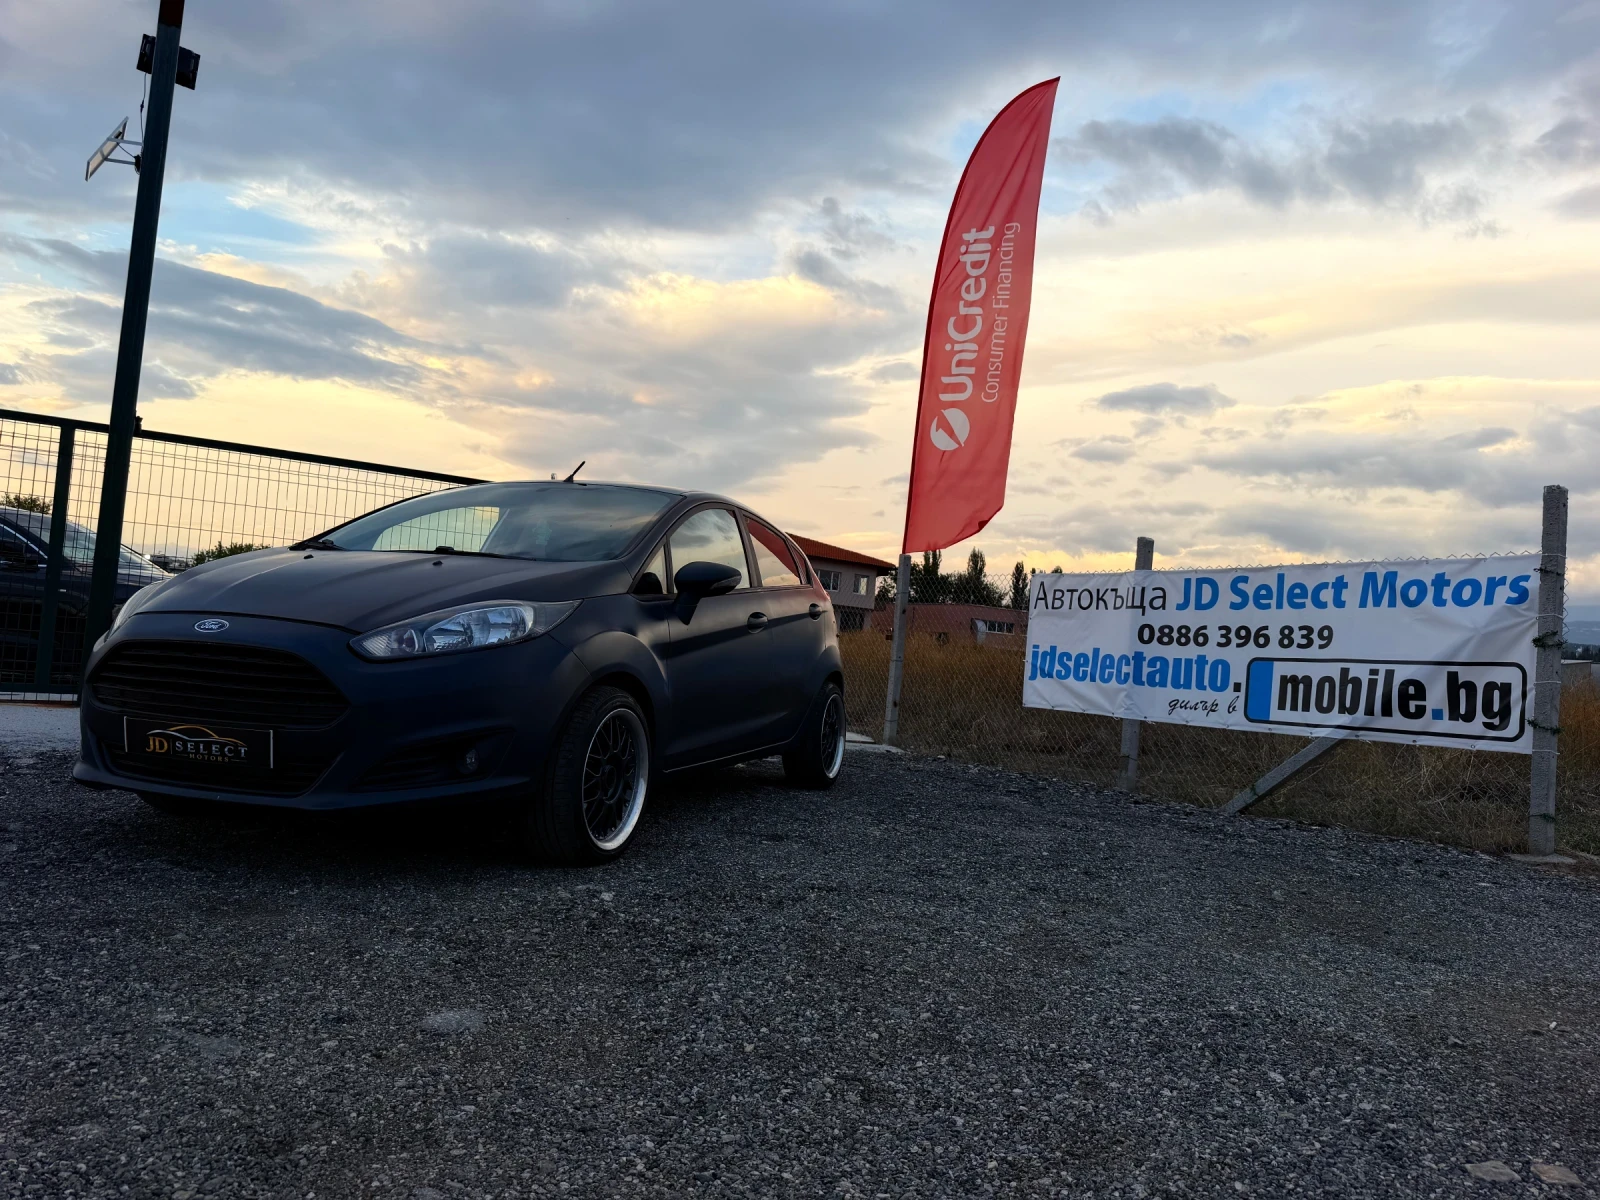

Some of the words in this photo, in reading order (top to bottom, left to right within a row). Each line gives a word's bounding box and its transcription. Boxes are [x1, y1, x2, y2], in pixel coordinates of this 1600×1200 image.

[992, 222, 1021, 309] Financing
[938, 225, 995, 401] UniCredit
[981, 316, 1008, 403] Consumer
[1033, 581, 1167, 616] Автокъща
[1175, 576, 1220, 611] JD
[1229, 573, 1349, 611] Select
[1358, 571, 1532, 609] Motors
[200, 620, 222, 630] Ford
[1137, 623, 1209, 647] 0886
[1216, 625, 1271, 649] 396
[1277, 625, 1334, 650] 839
[1277, 667, 1512, 732] mobile.bg
[145, 736, 168, 753] JD
[175, 741, 248, 758] SELECT
[189, 753, 229, 763] MOTORS
